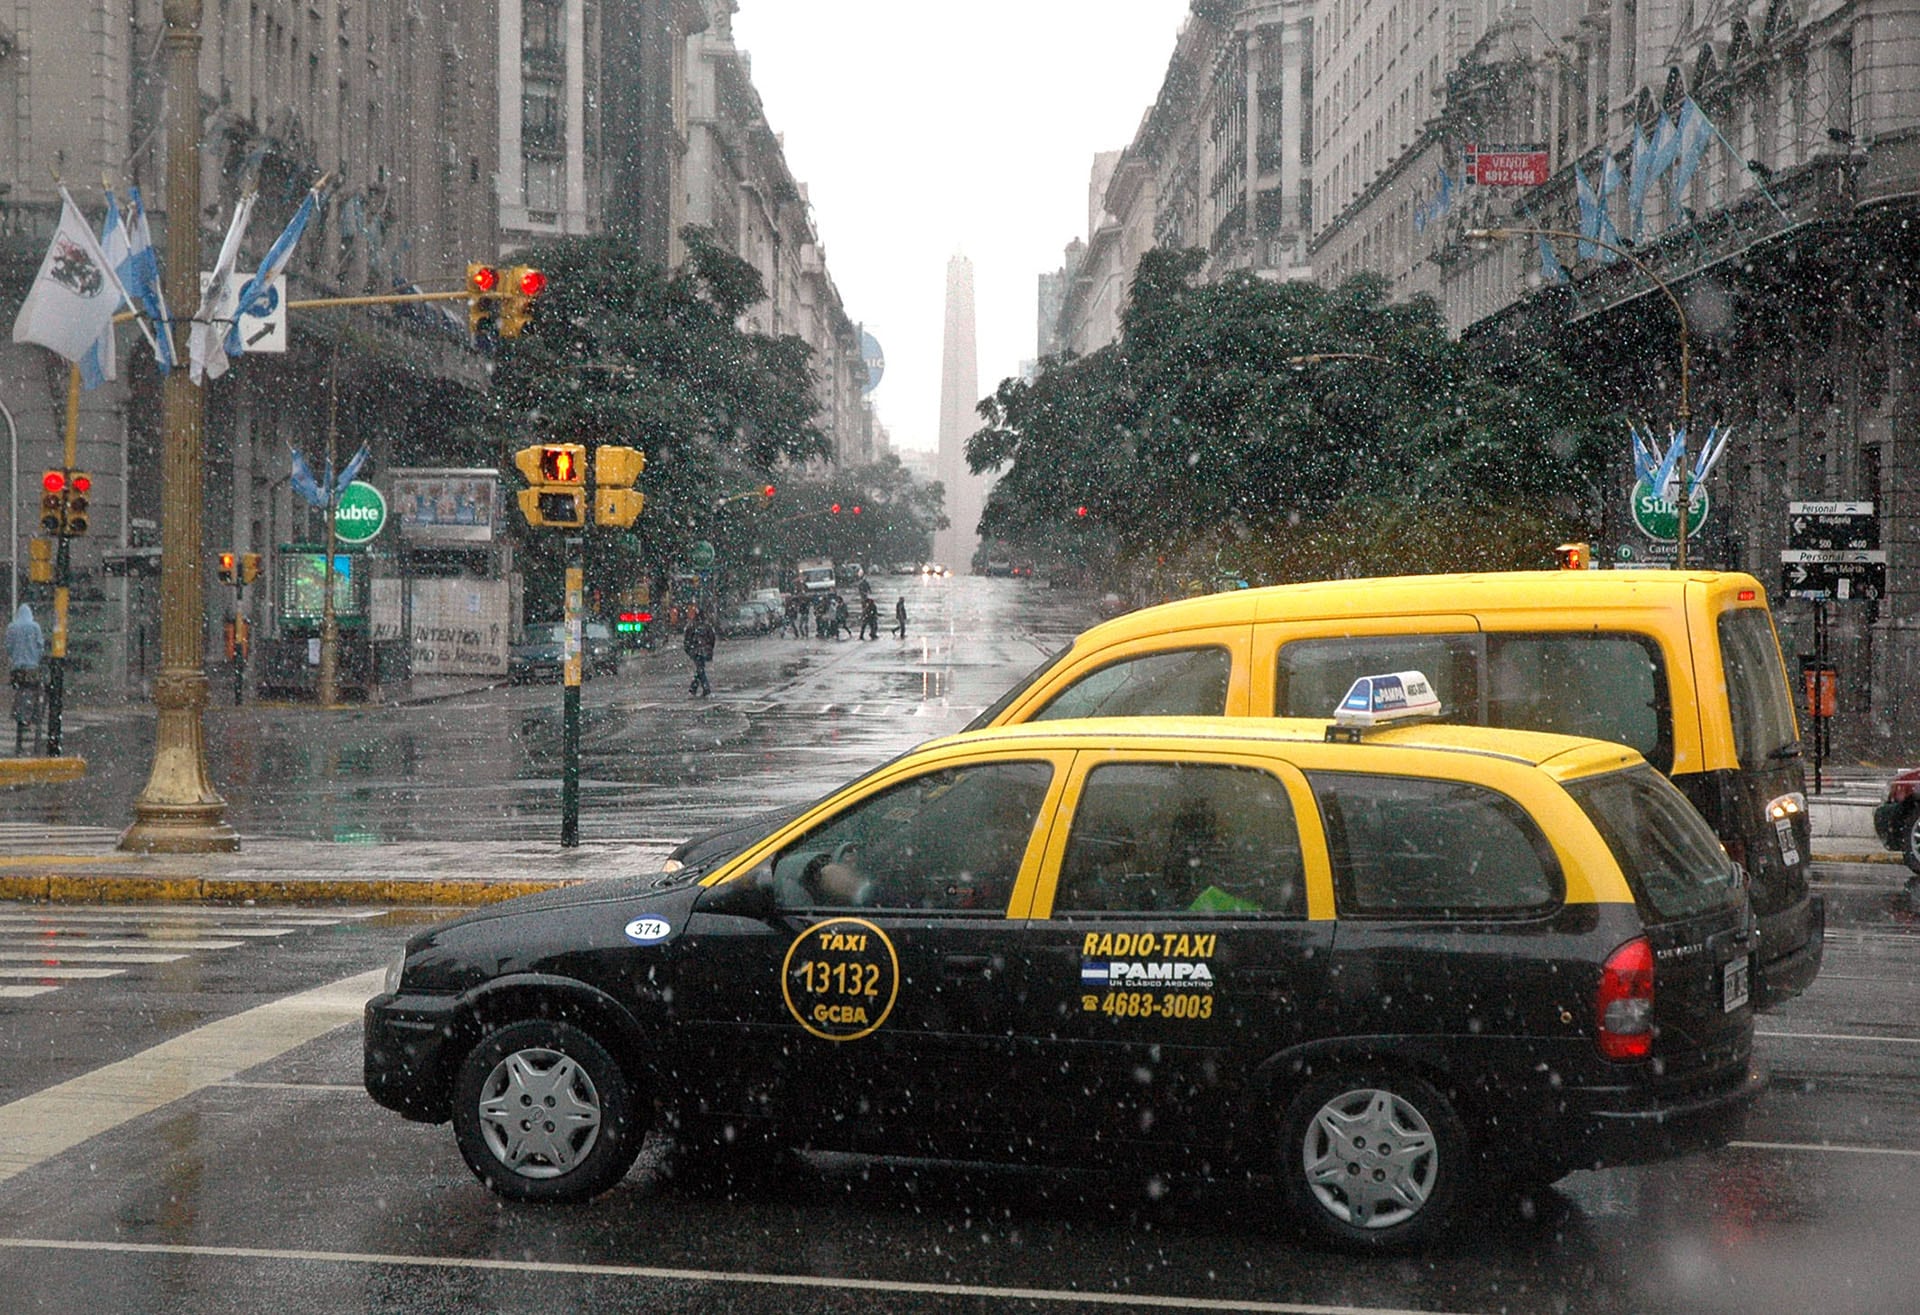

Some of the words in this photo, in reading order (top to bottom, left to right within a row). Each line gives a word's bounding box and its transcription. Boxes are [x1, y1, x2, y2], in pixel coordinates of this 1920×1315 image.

[1492, 157, 1528, 168] VENDE
[1802, 504, 1837, 513] Personal
[1622, 548, 1631, 557] D
[1649, 544, 1690, 554] Catedl
[1800, 553, 1845, 562] Personal
[635, 923, 661, 935] 374
[820, 934, 867, 952] TAXI
[1083, 932, 1216, 958] RADIO-TAXI
[1109, 962, 1212, 979] PAMPA
[800, 961, 880, 996] 13132
[1165, 980, 1213, 988] ARGENTINO
[1102, 993, 1213, 1018] 4683-3003
[814, 1004, 868, 1023] GCBA
